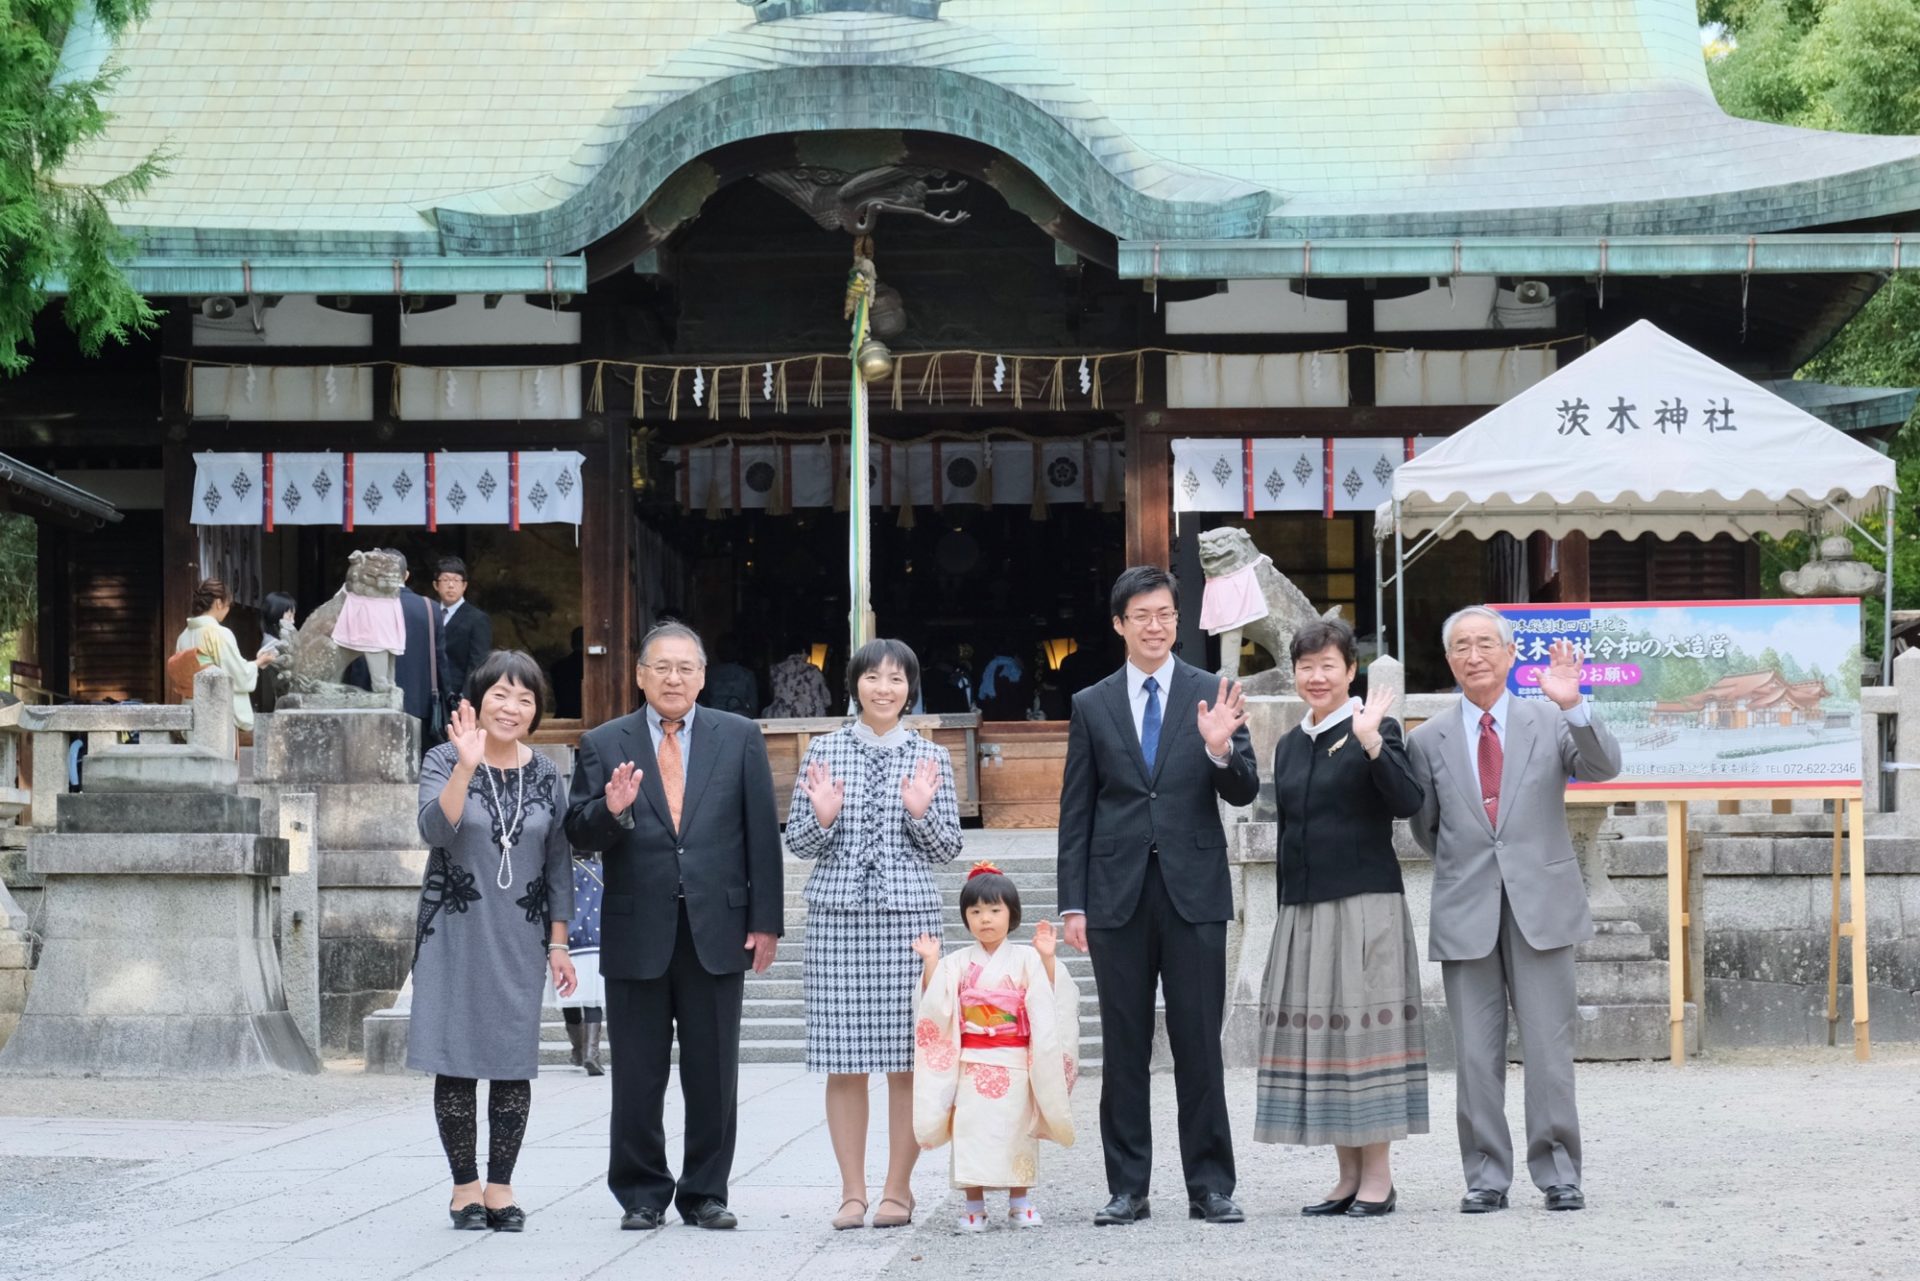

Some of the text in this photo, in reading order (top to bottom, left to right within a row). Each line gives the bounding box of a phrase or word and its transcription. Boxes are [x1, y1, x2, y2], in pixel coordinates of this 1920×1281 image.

[1555, 396, 1738, 436] 茨木神社
[1765, 764, 1781, 774] TEL
[1783, 762, 1857, 774] 072-622-2346
